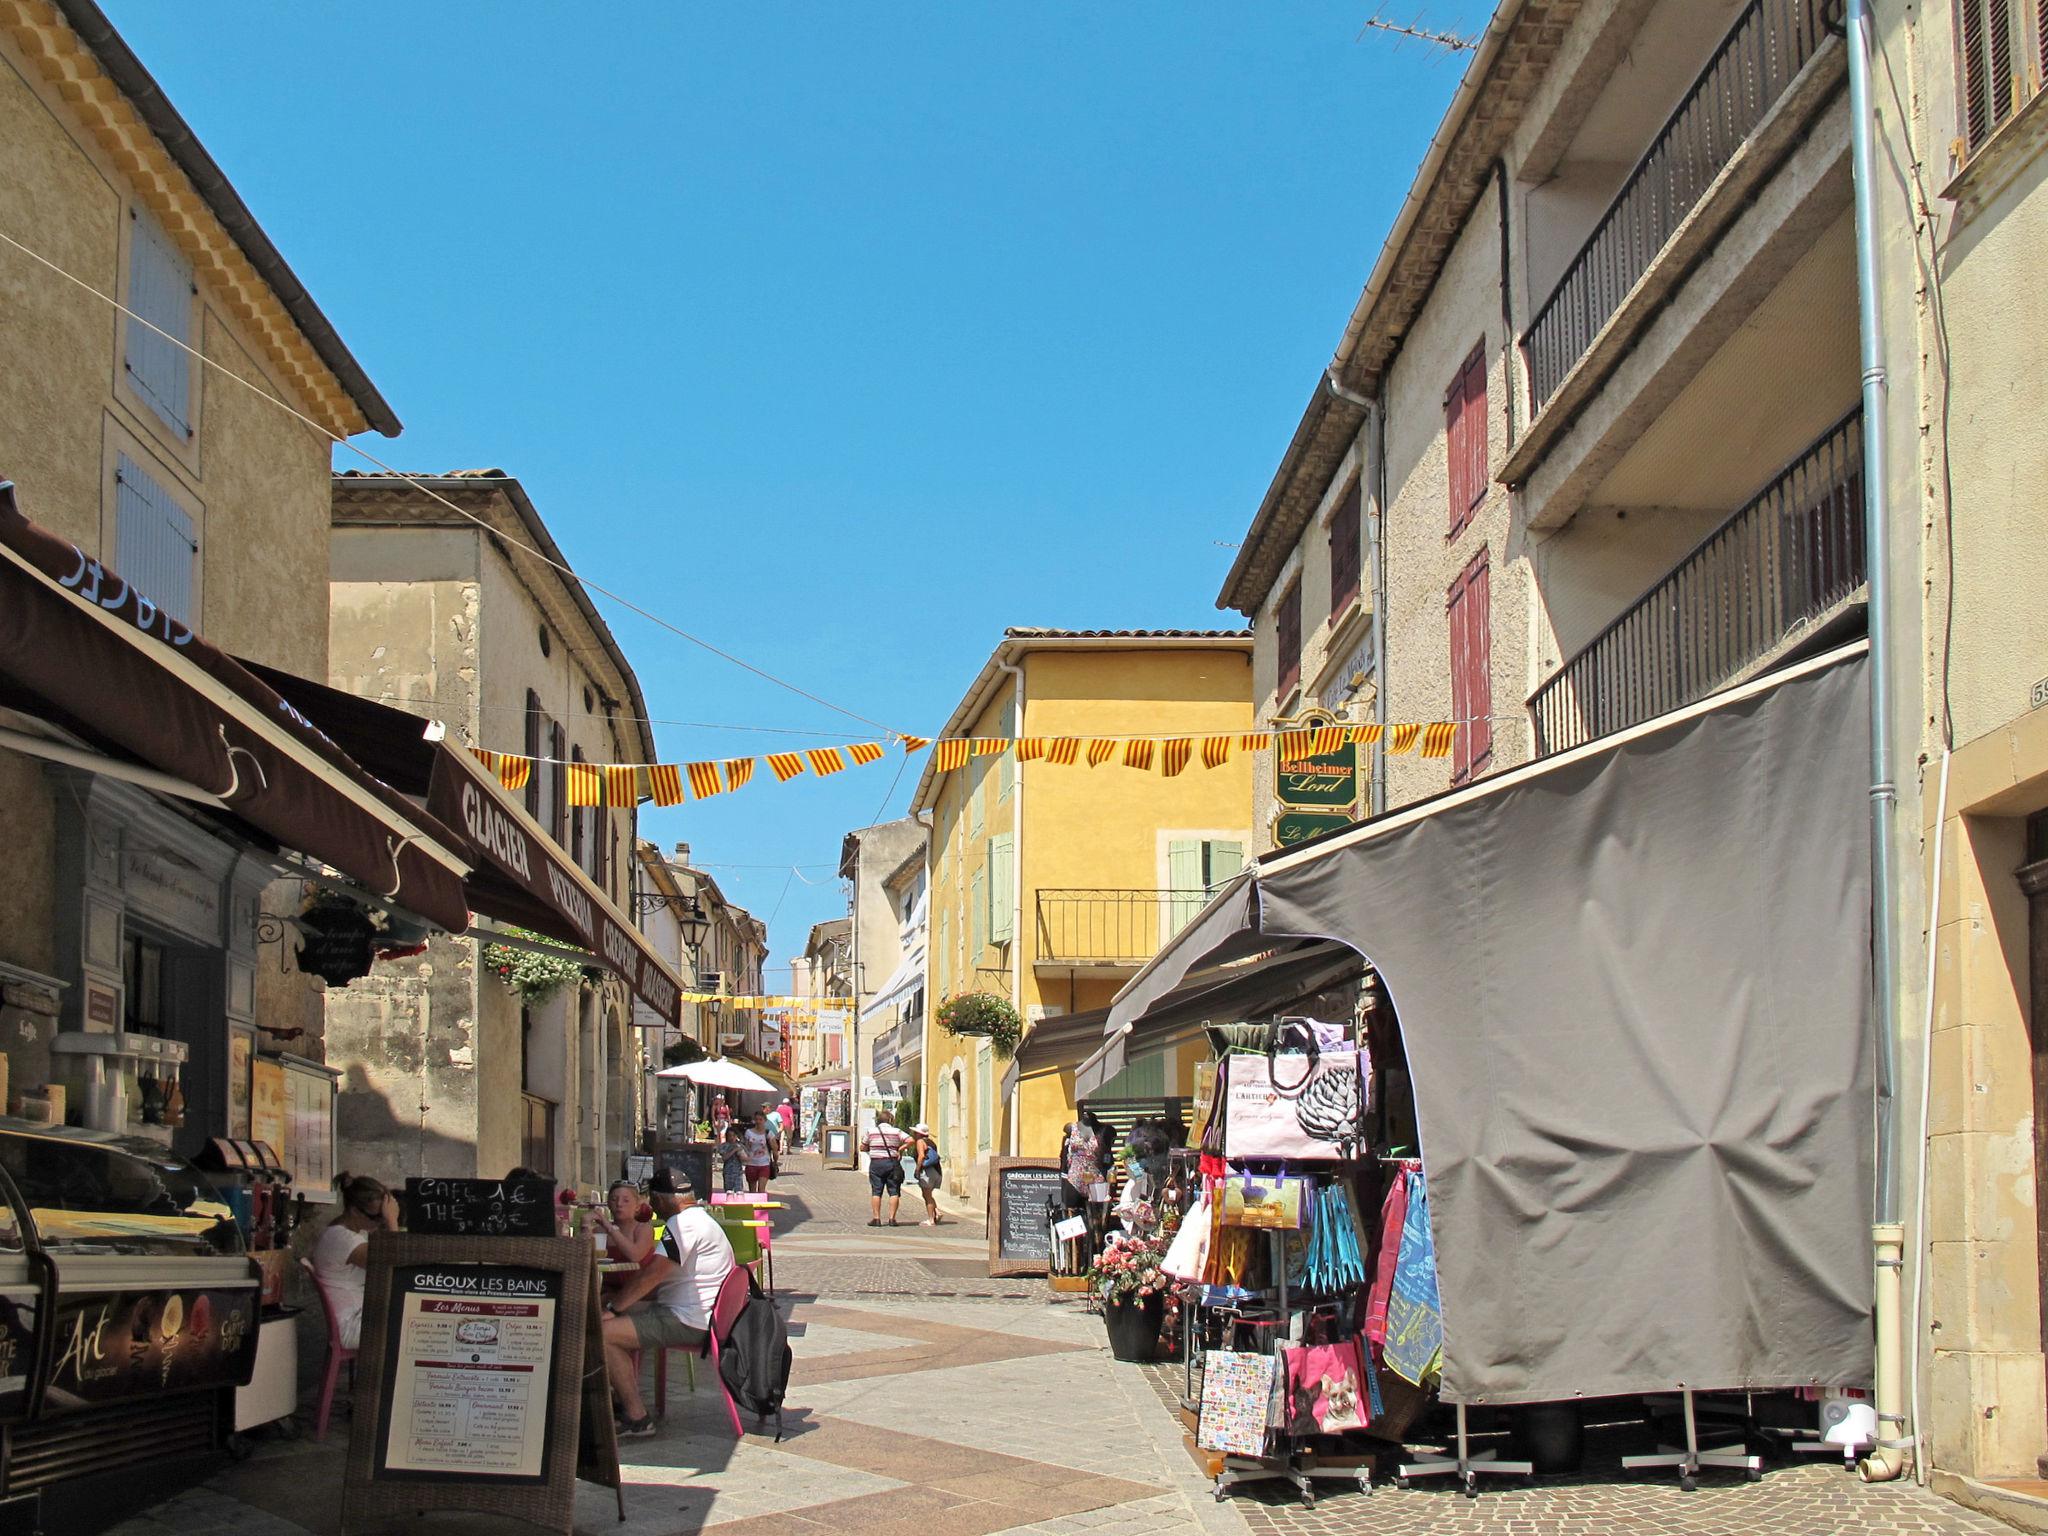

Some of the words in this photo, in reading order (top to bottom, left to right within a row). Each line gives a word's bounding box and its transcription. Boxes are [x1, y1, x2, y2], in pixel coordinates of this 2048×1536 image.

[1280, 760, 1353, 775] Bellheimer
[1288, 774, 1345, 793] Lord
[1281, 826, 1301, 840] Le
[462, 781, 531, 882] GLACIER
[546, 859, 595, 943] PIZZERIA
[641, 961, 675, 1019] BRASSERIE
[488, 1183, 505, 1201] 1
[510, 1185, 536, 1204] €
[414, 1273, 477, 1289] GRÉOUX
[481, 1279, 503, 1290] LES
[507, 1279, 547, 1292] BAINS
[433, 1302, 449, 1313] Les
[450, 1302, 481, 1313] Menus
